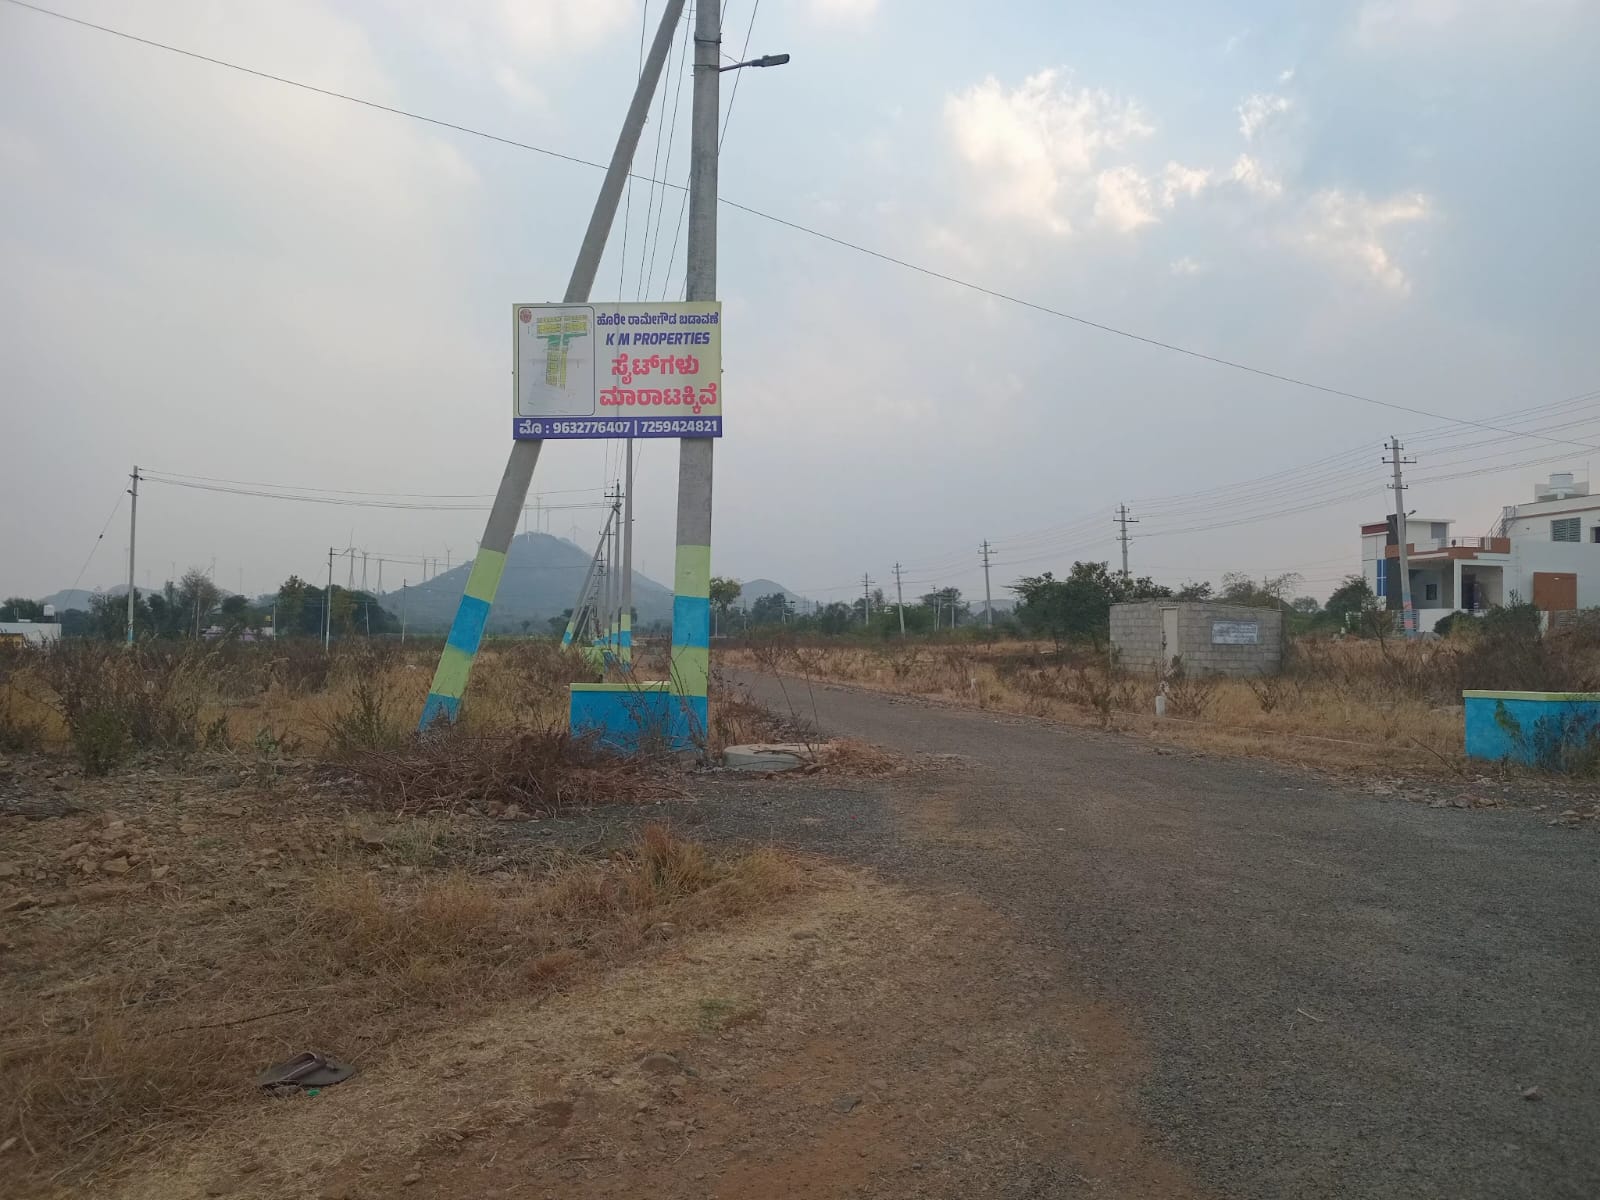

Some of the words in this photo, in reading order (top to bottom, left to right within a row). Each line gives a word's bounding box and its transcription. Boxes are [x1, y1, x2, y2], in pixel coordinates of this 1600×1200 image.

[628, 312, 676, 325] ರಾಮೇಗೌಡ
[679, 312, 719, 324] ಬಡಾವಣೆ
[606, 333, 615, 345] K
[618, 333, 629, 345] M
[633, 332, 710, 345] PROPERTIES
[600, 383, 717, 413] ಮಾರಾಟಕ್ಕಿವೆ
[519, 420, 541, 433] ಮೊ
[553, 421, 631, 434] 9632776407
[641, 420, 717, 433] 7259424821
